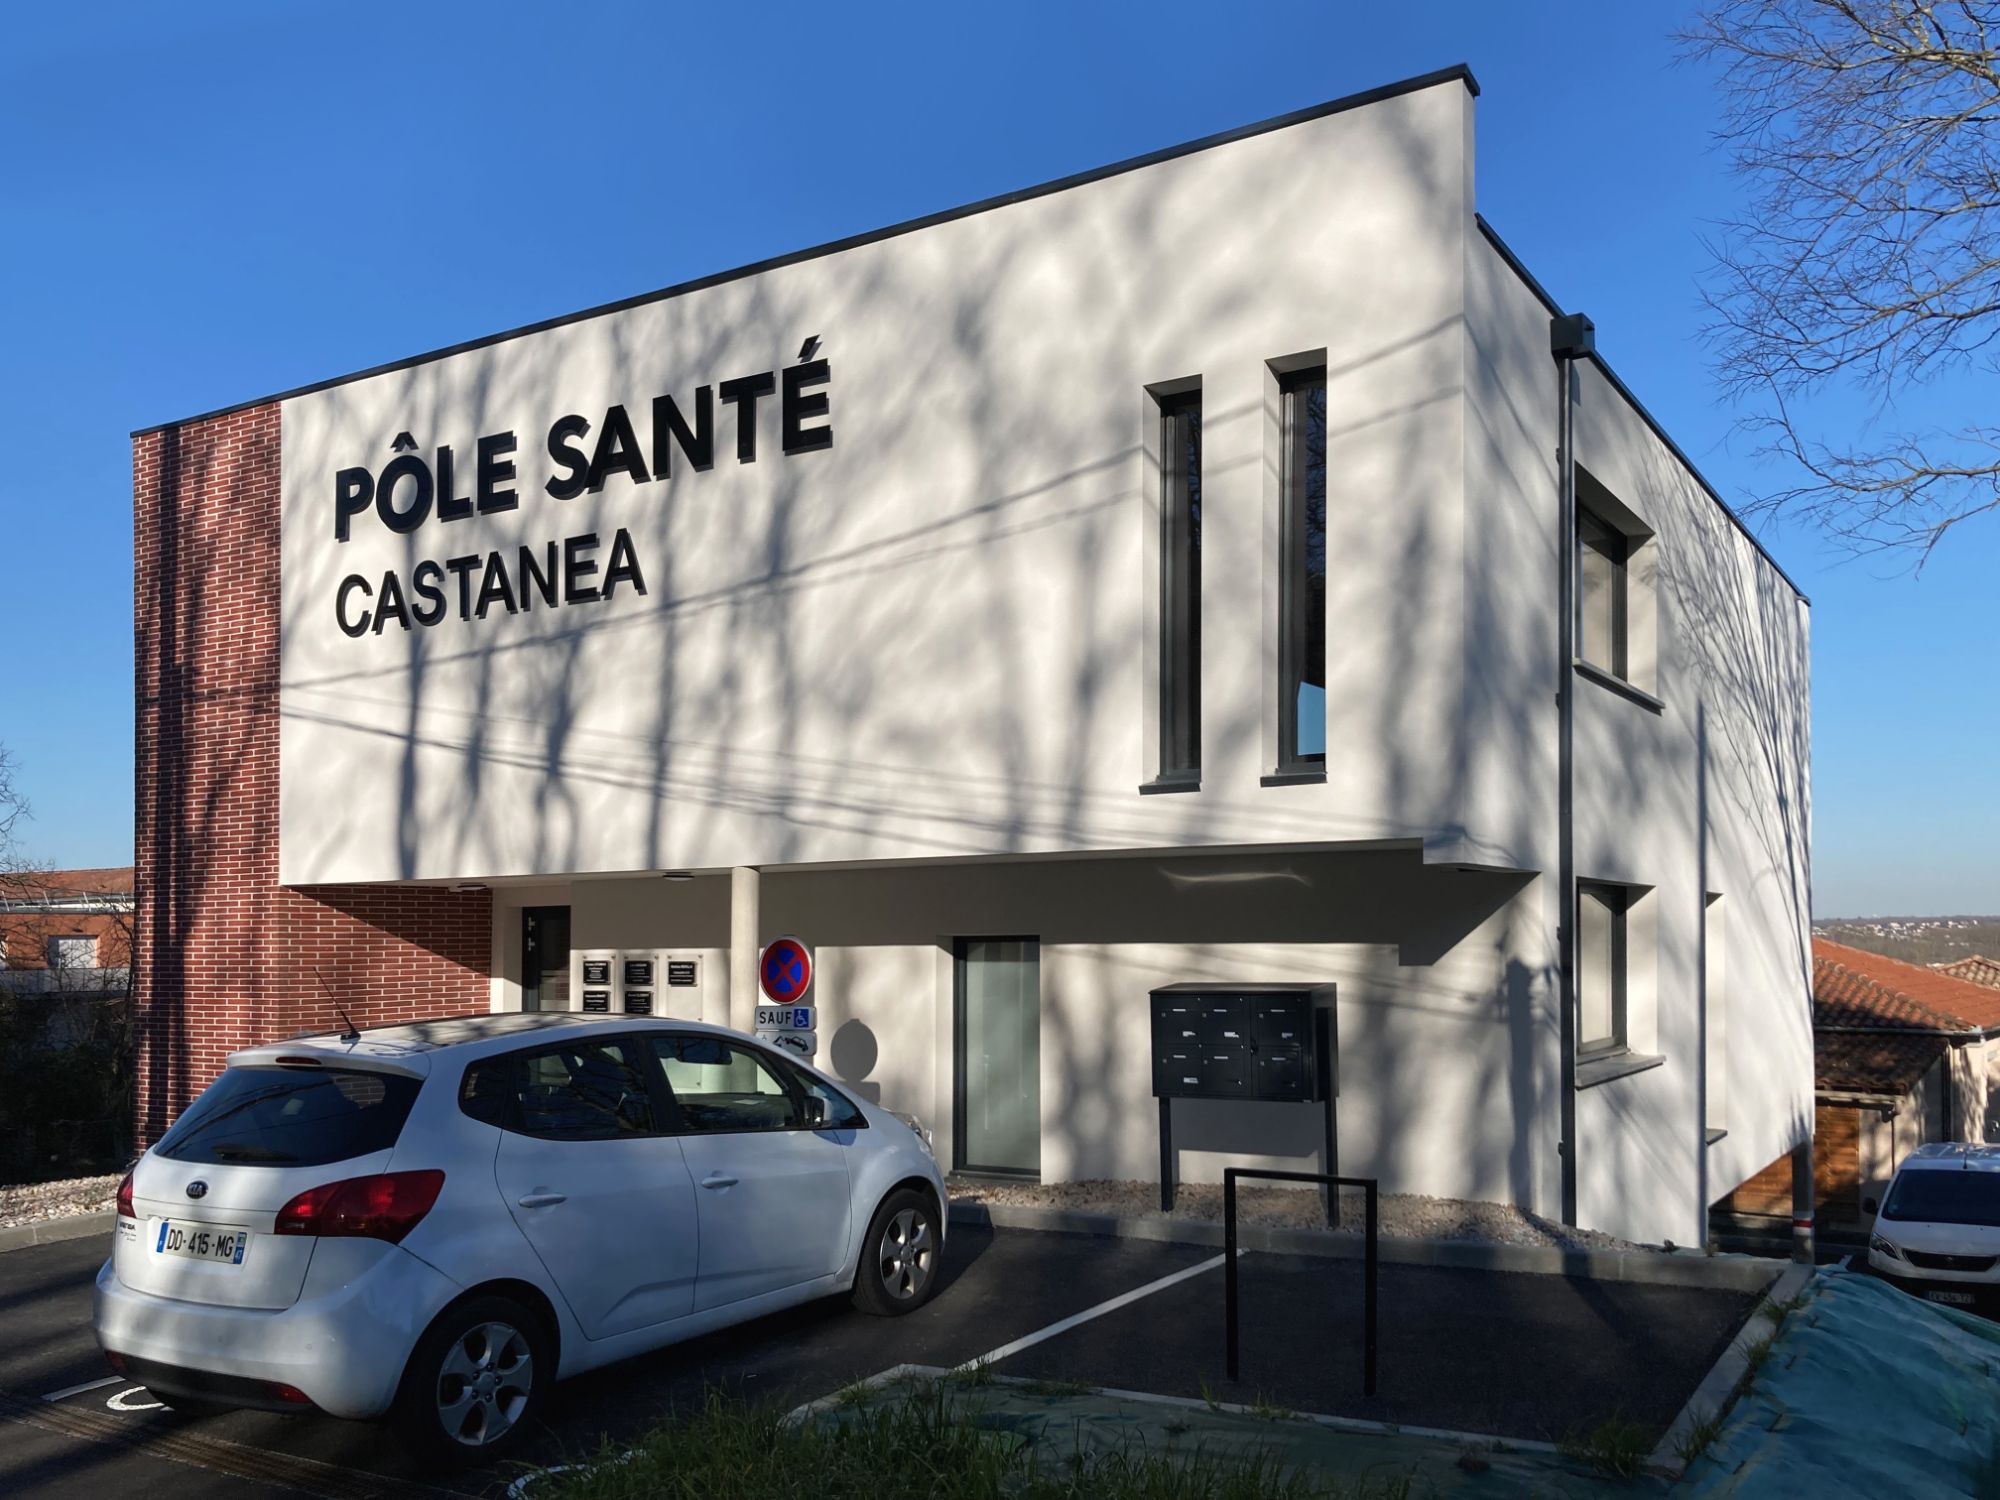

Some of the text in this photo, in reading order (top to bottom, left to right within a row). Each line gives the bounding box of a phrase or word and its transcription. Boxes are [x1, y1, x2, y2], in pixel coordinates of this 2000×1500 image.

[335, 334, 833, 542] PÔLE SANTÉ
[335, 527, 648, 638] CASTANEA
[759, 1011, 792, 1025] SAUF
